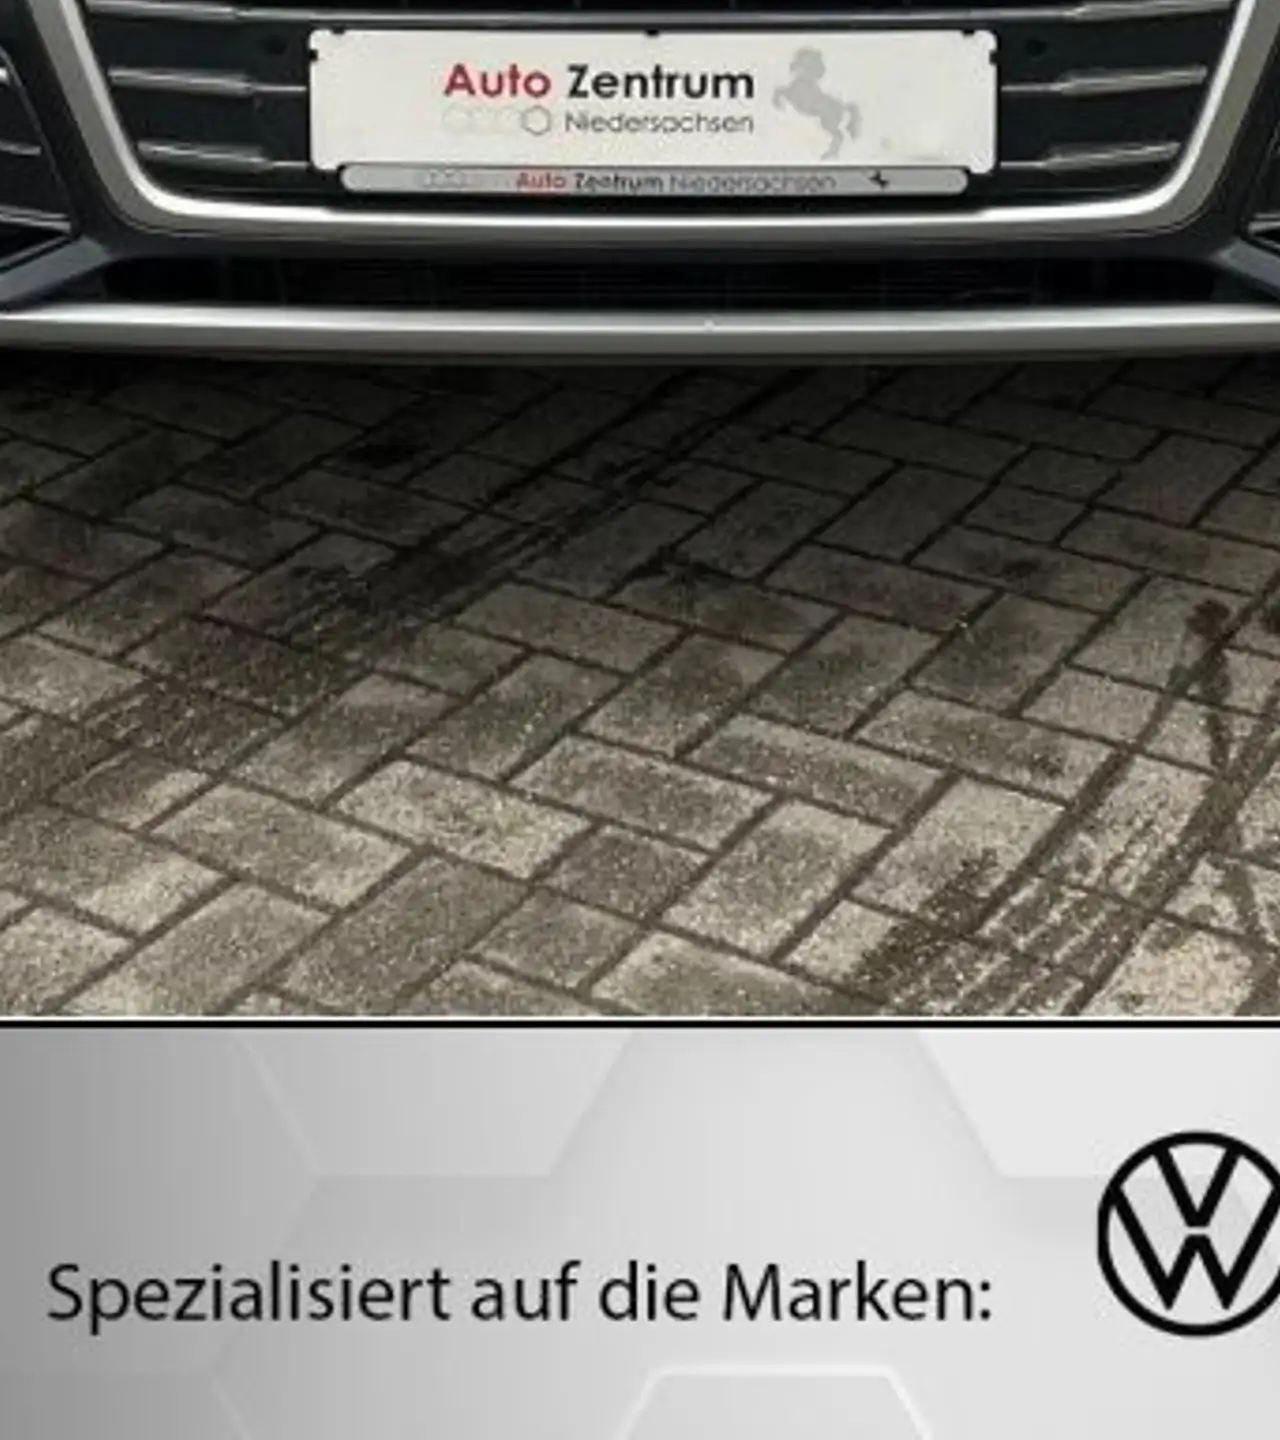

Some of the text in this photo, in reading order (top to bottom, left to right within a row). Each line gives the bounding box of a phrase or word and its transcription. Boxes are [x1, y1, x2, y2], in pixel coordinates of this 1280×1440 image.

[443, 63, 755, 99] Auto Zentrum
[564, 109, 755, 134] Niedersachsen
[515, 172, 566, 191] Auto
[574, 172, 664, 194] Zentrum
